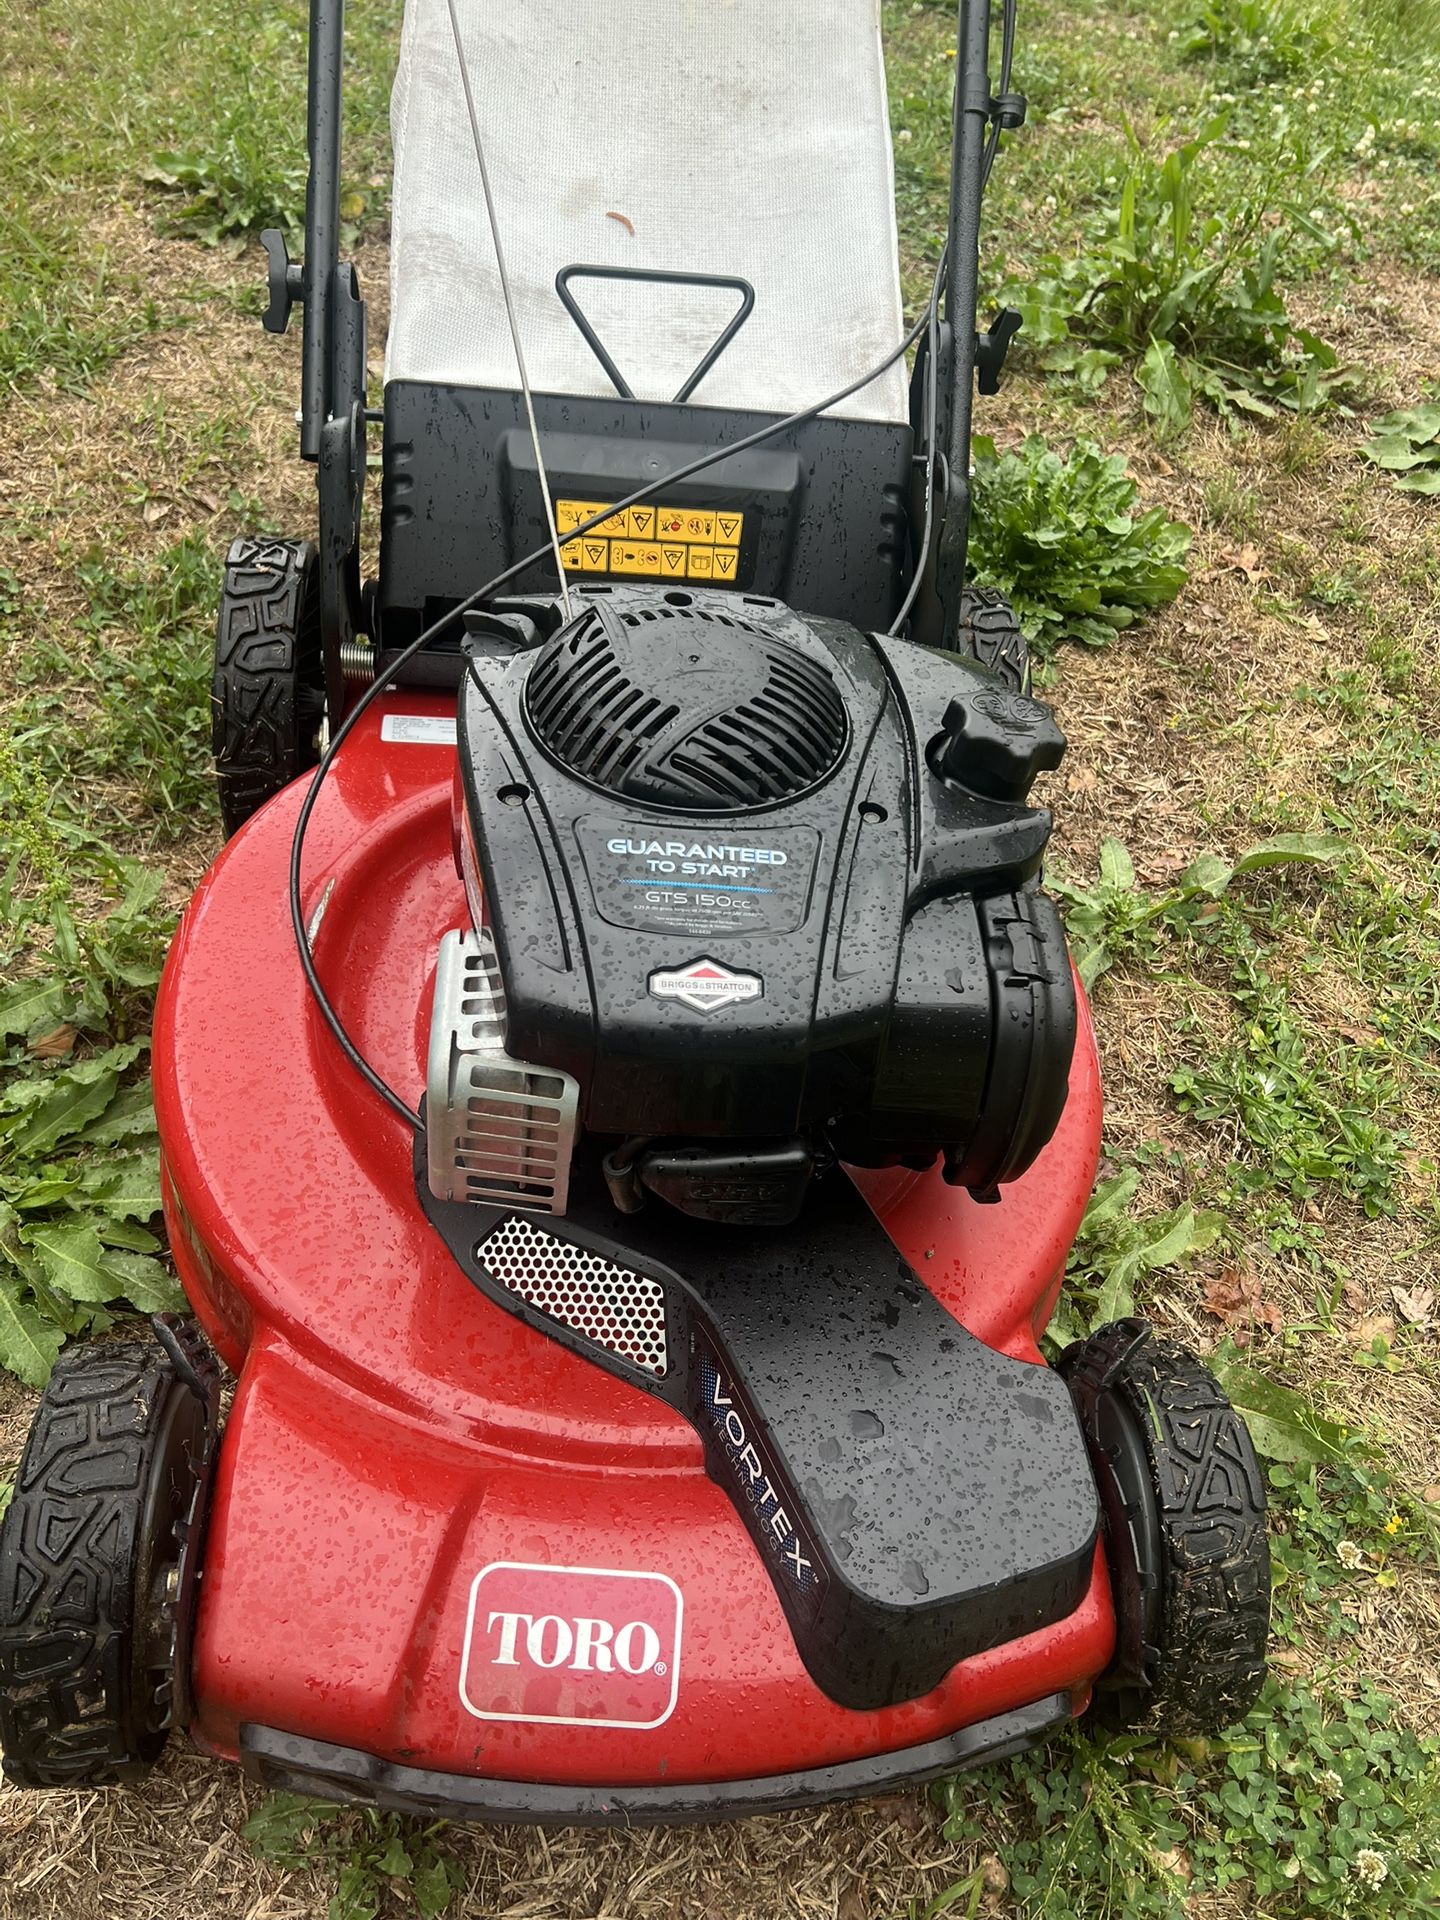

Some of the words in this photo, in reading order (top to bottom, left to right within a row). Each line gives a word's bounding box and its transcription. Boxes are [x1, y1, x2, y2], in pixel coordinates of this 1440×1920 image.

[607, 838, 788, 865] GUARANTEED
[646, 859, 676, 873] TO
[645, 891, 688, 904] GTS
[695, 893, 752, 909] 150cc
[712, 1415, 788, 1564] TECHNOLOGY
